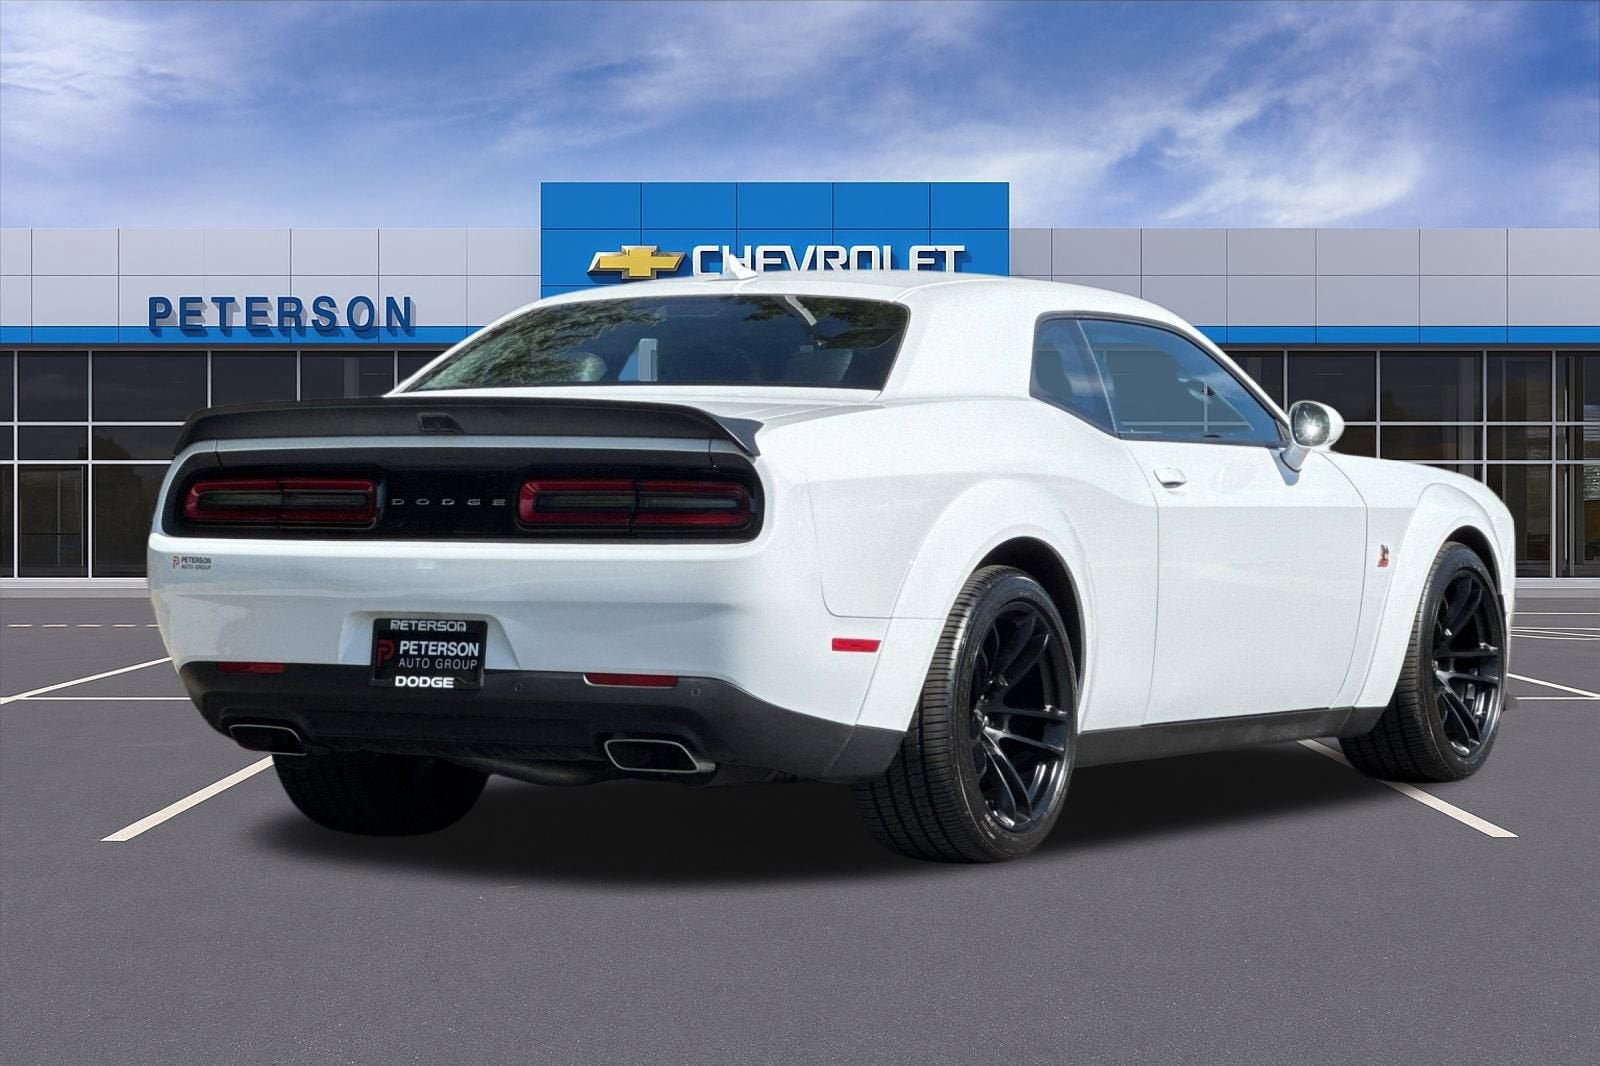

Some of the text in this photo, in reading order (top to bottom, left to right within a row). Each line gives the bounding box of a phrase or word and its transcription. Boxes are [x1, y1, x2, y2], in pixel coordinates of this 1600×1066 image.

[692, 244, 965, 276] CHEVROLET
[148, 295, 412, 333] PETERSON
[391, 498, 506, 506] DODGE
[181, 556, 212, 564] PETERSON
[399, 640, 479, 657] PETERSON
[398, 658, 478, 670] AUTO GROUP
[395, 675, 455, 689] DODGE
